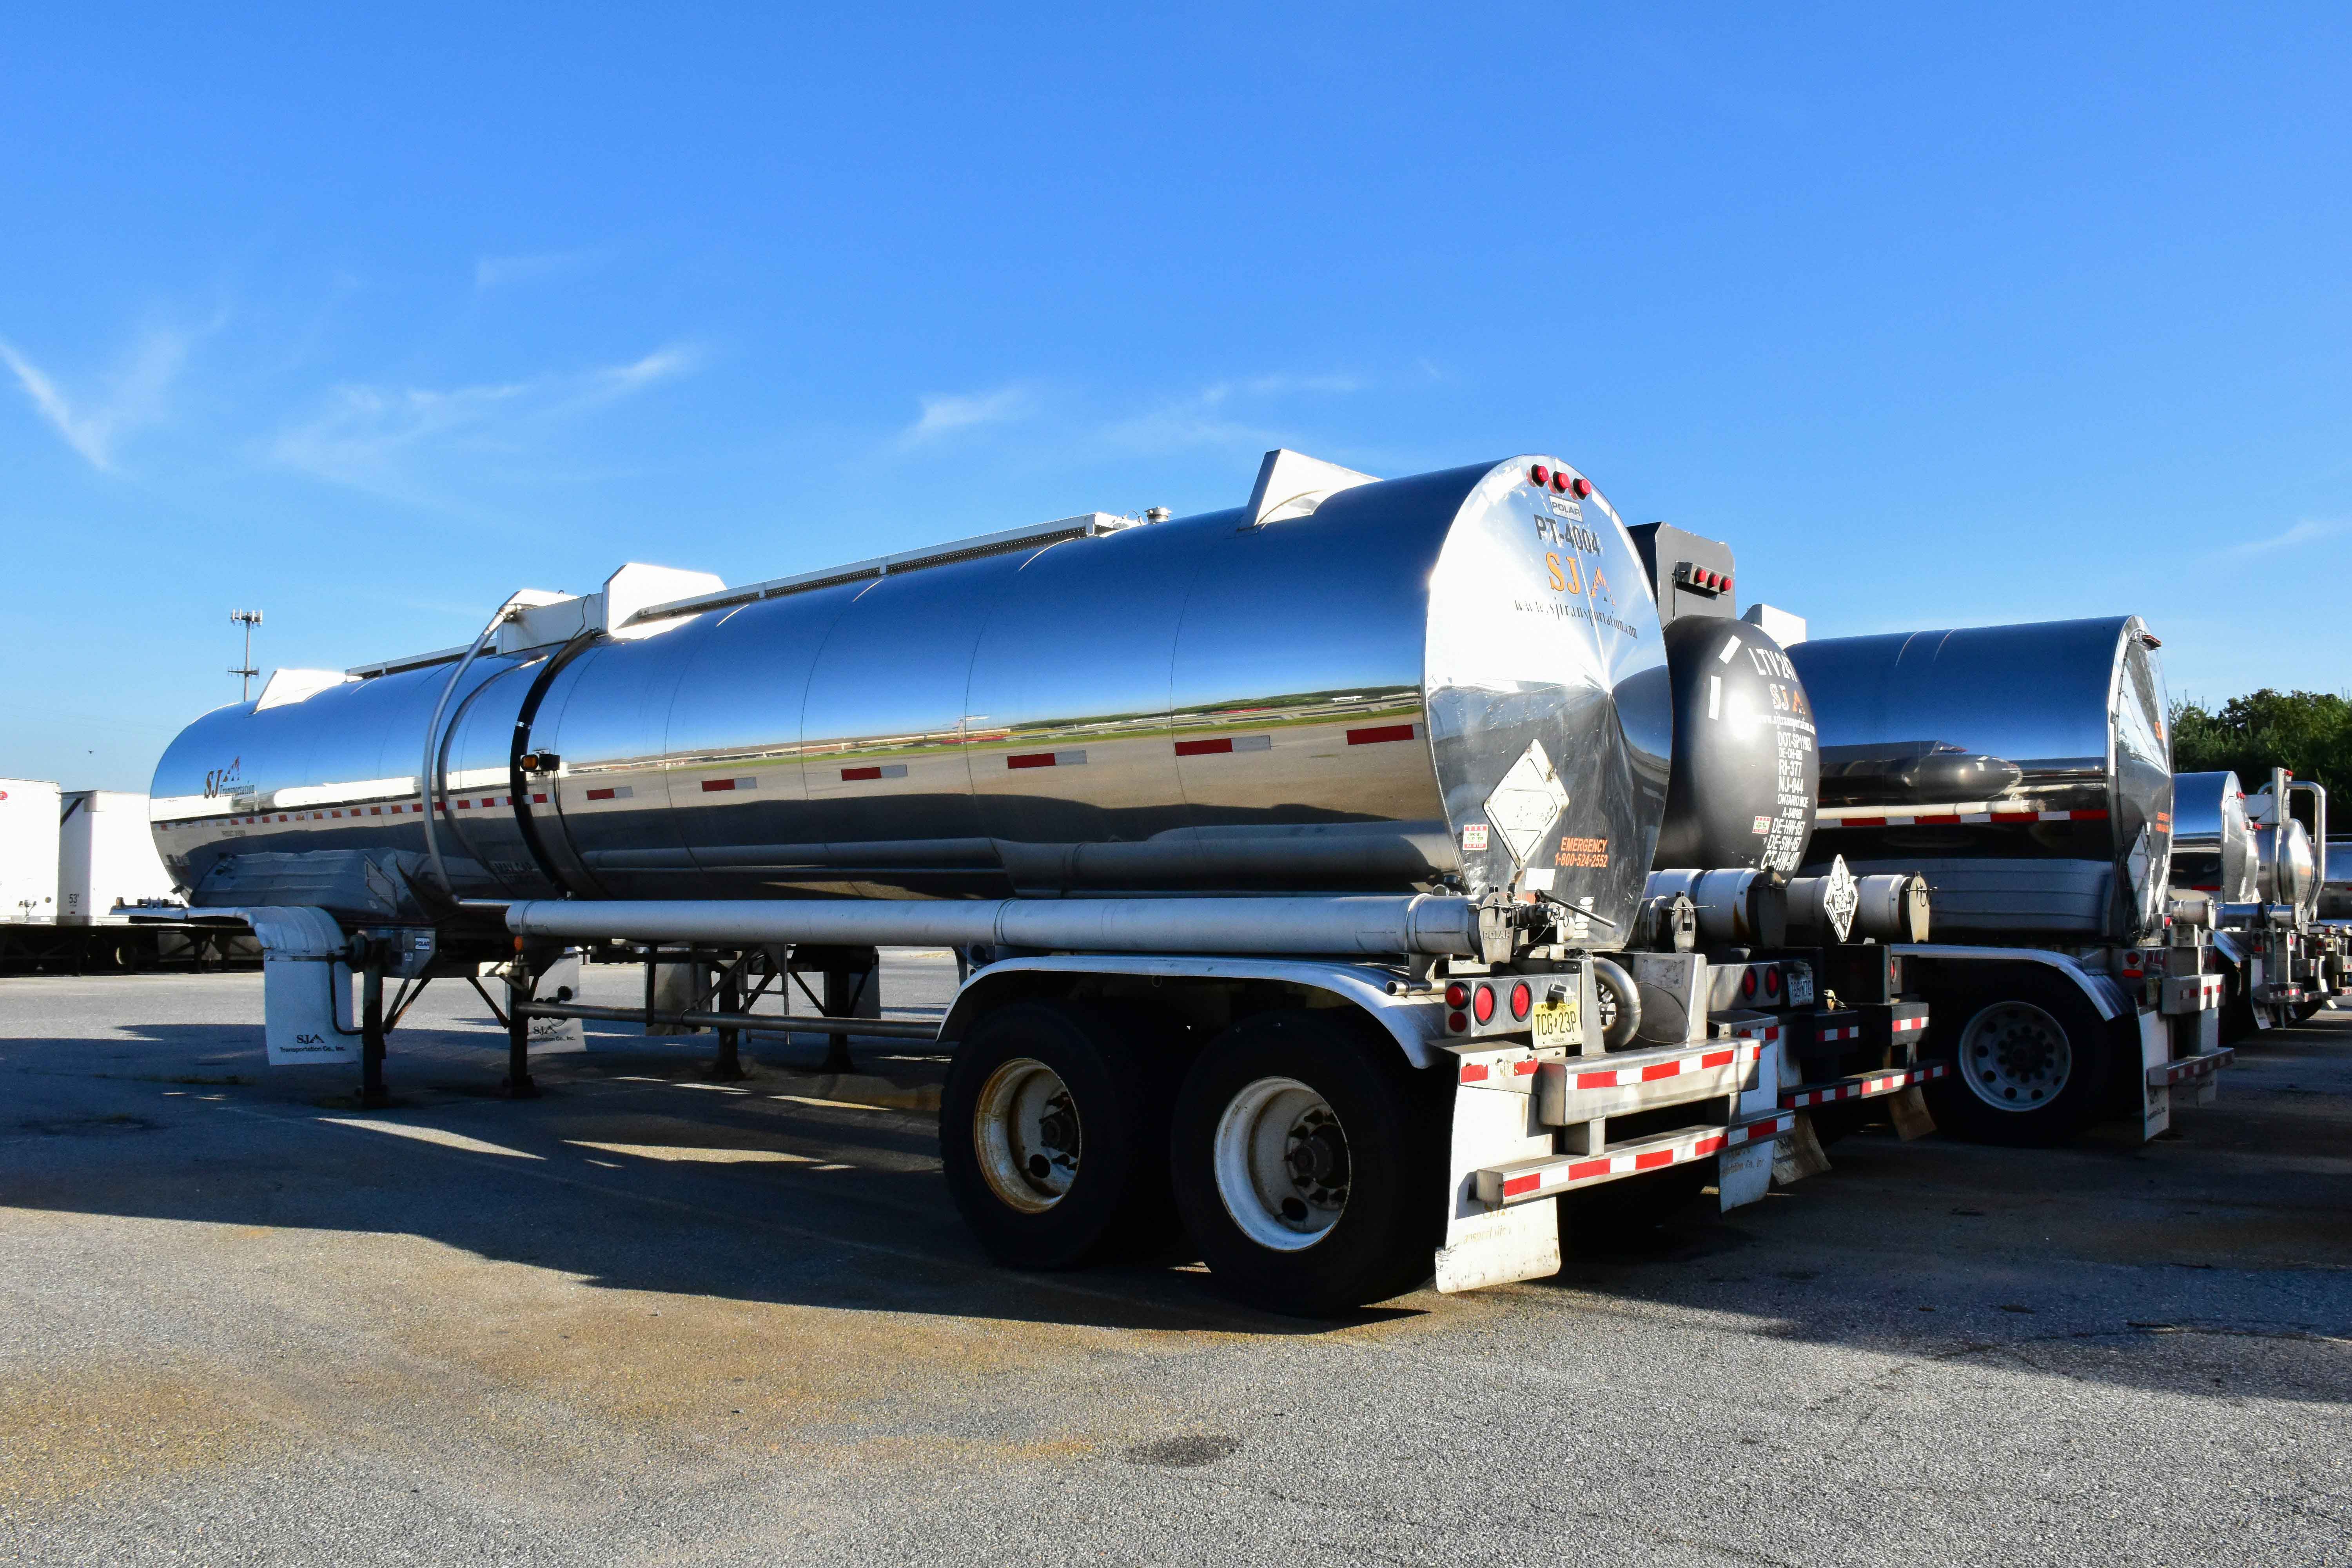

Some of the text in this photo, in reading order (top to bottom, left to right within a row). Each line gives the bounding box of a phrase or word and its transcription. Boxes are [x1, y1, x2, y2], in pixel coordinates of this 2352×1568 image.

[1552, 502, 1581, 516] POLAR
[1534, 514, 1600, 557] PT-4004
[1515, 596, 1637, 639] www.sjtransportation.com
[1779, 759, 1802, 777] RI-377
[1778, 775, 1803, 794] NJ-044
[1777, 793, 1800, 806] ONTARIO
[1561, 837, 1608, 853] EMERGENCY
[1555, 852, 1608, 867] 1-800-524-2552
[1483, 929, 1512, 940] POLAR
